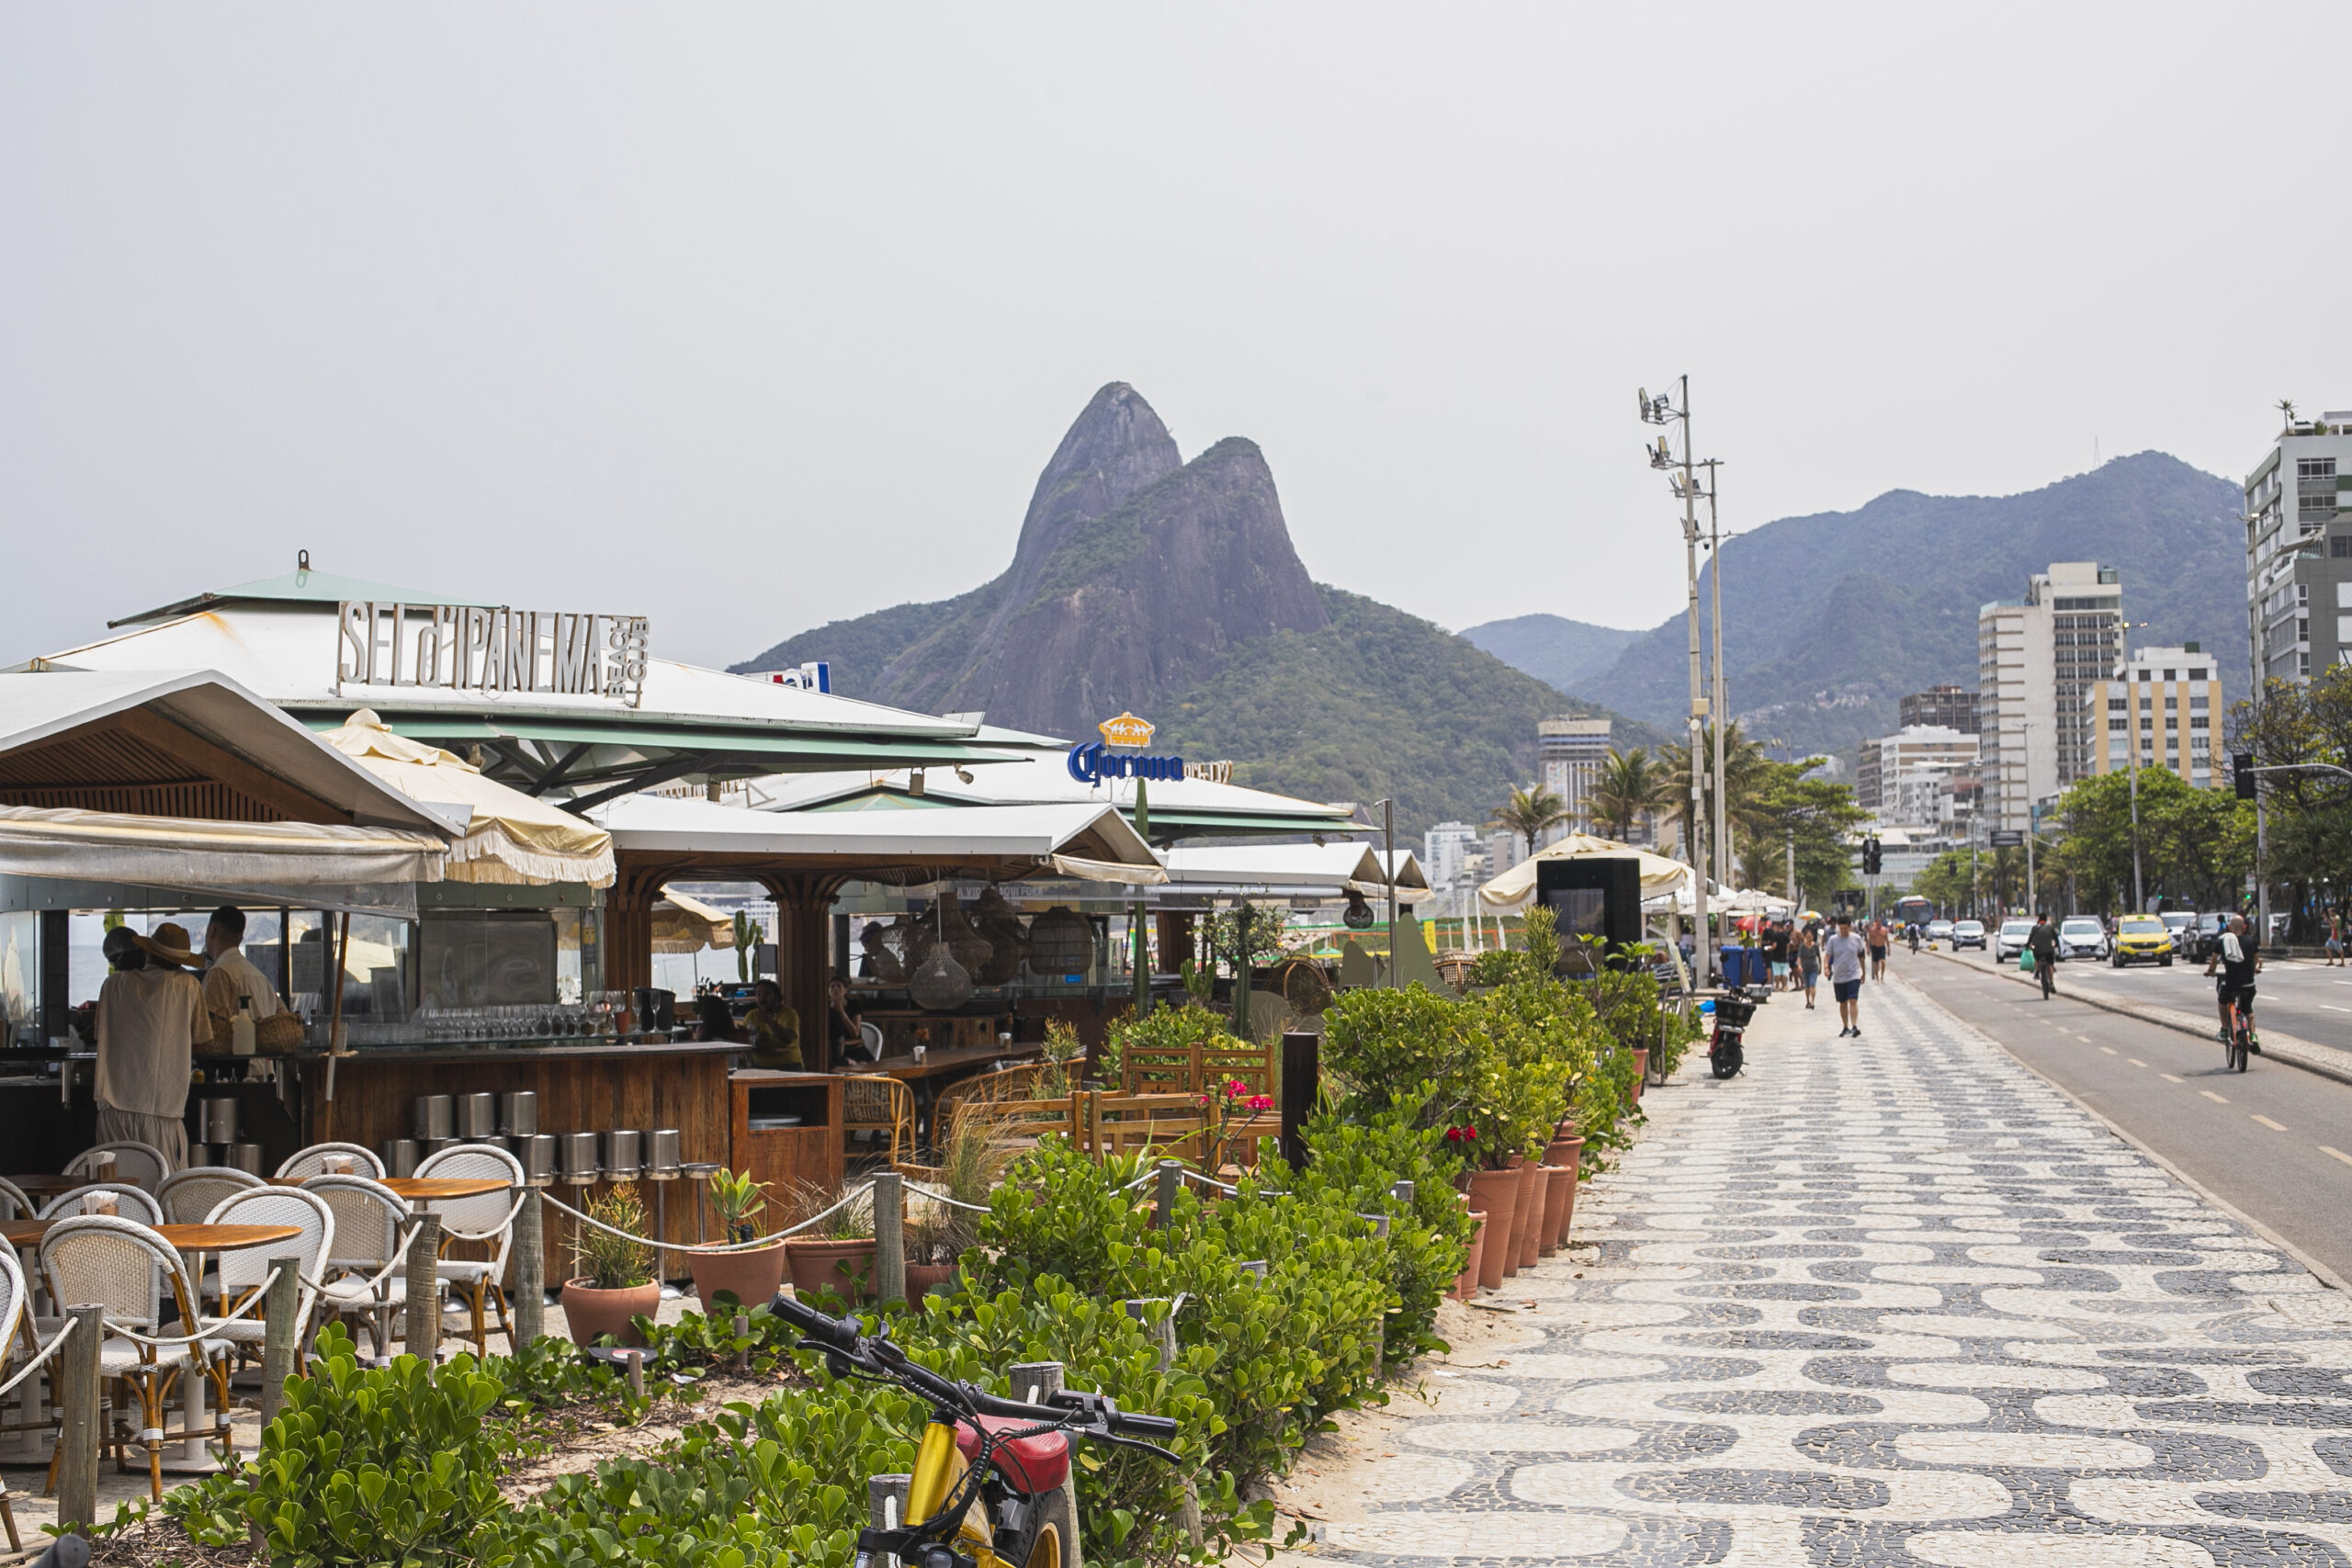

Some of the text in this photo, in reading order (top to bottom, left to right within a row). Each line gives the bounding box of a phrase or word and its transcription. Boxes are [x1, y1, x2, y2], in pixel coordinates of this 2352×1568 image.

[340, 600, 416, 687] SEL
[606, 616, 631, 698] BEACH
[628, 619, 650, 682] CLUB
[1067, 742, 1185, 788] Corona
